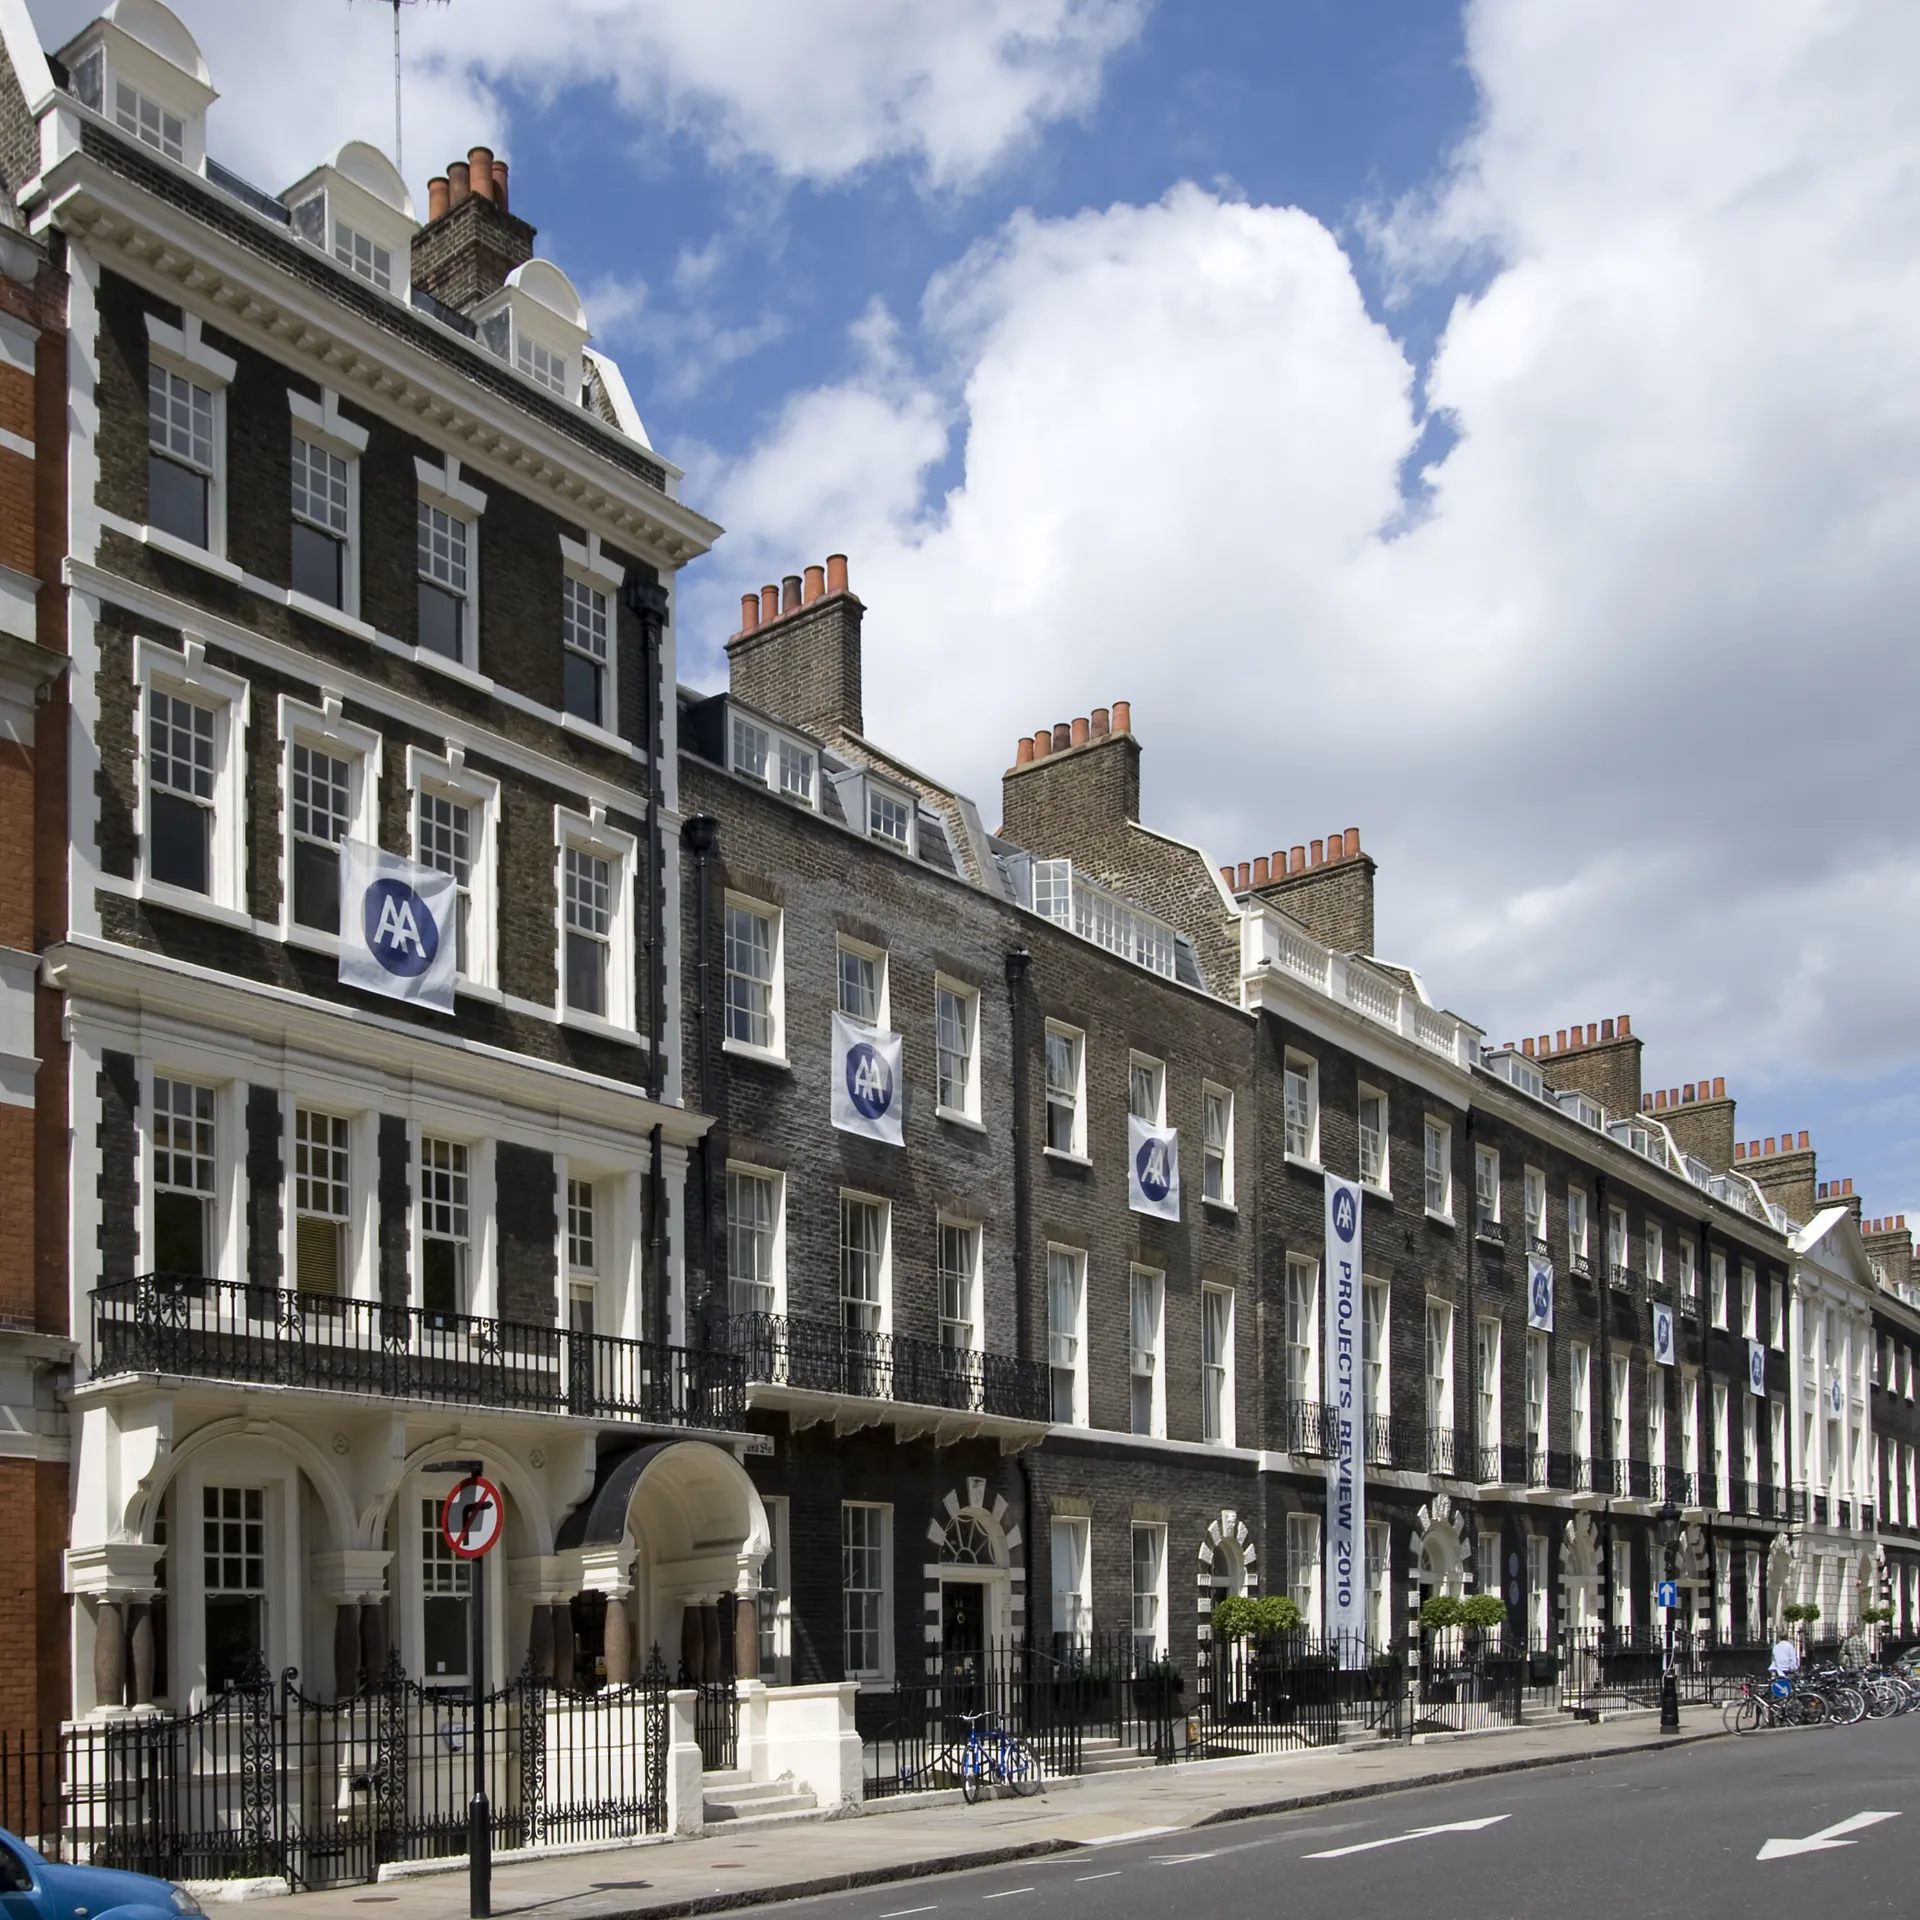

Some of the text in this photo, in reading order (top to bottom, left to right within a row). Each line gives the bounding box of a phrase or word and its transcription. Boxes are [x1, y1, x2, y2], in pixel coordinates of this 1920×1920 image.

[373, 894, 427, 958] AA
[854, 1054, 885, 1104] AA
[1336, 1196, 1353, 1231] AA
[1337, 1260, 1352, 1608] PROJECTS REVIEW 2010
